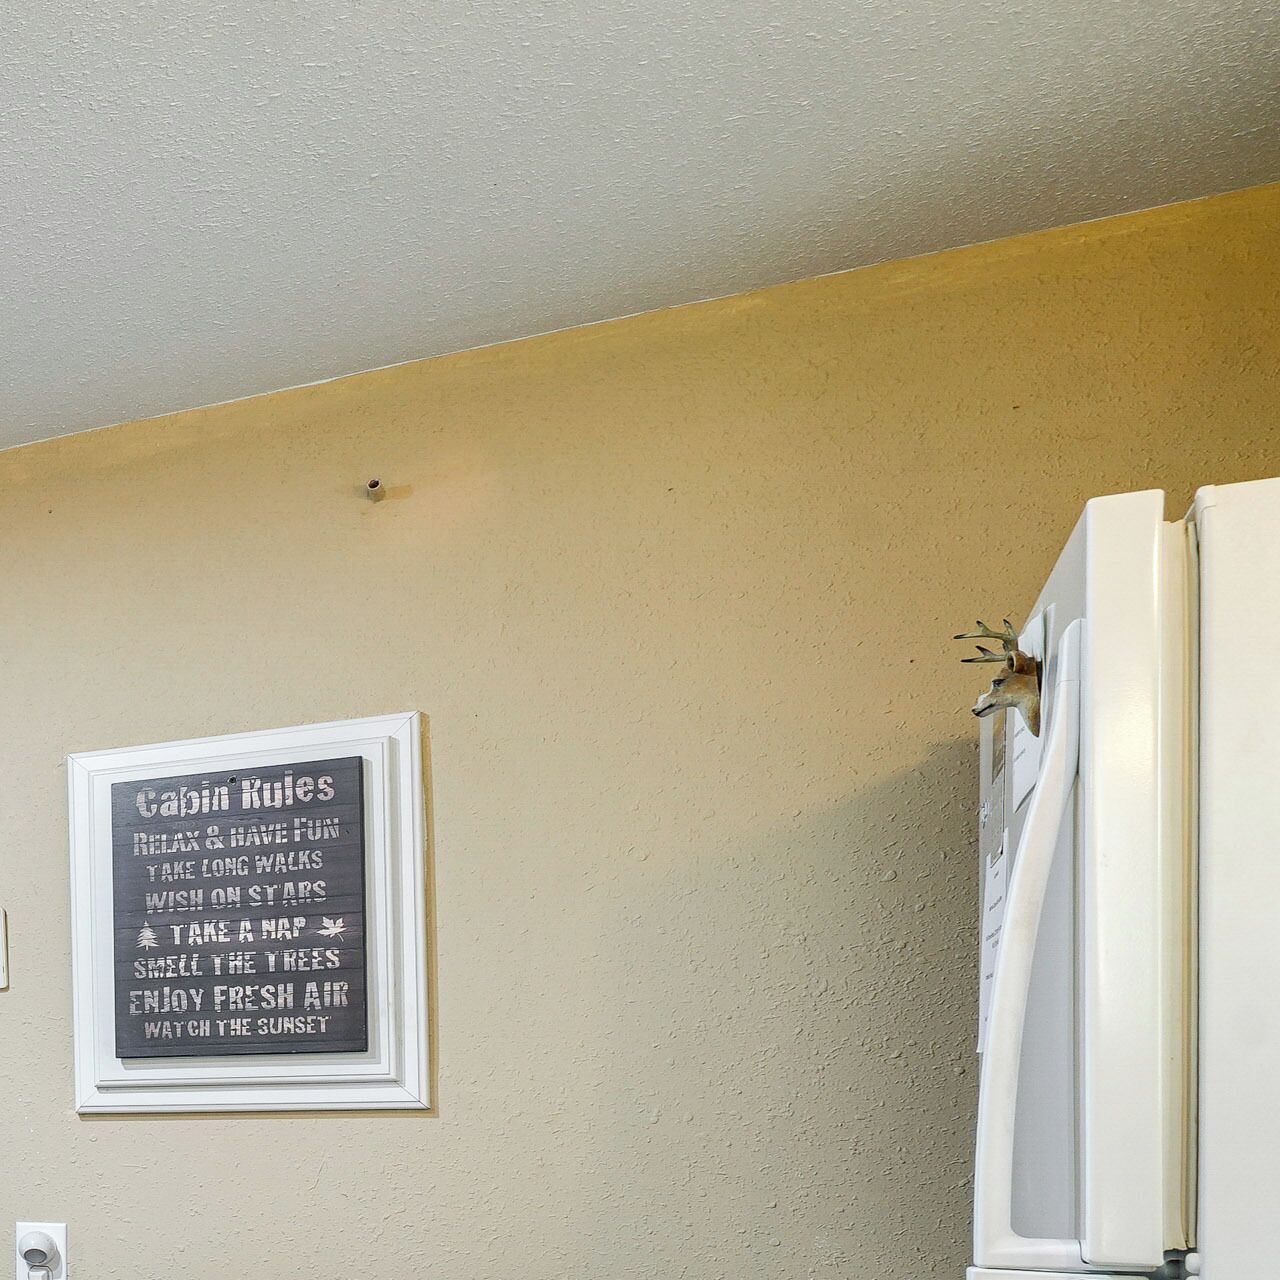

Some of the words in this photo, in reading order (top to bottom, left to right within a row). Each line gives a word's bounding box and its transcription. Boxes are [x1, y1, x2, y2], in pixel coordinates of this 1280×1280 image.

[136, 780, 230, 818] Cabin
[241, 770, 335, 809] Rules
[133, 830, 201, 857] RELAX
[205, 825, 225, 850] &
[230, 822, 288, 848] HAVE
[293, 817, 339, 842] FUN
[146, 861, 196, 883] TAKE
[201, 855, 249, 878] LONG
[255, 850, 324, 874] WALKS
[145, 889, 203, 915] WISH
[211, 886, 241, 910] ON
[248, 880, 327, 908] STARS
[169, 919, 231, 946] TAKE
[238, 917, 254, 944] A
[261, 916, 306, 941] NAP
[133, 953, 203, 979] SMELL
[211, 951, 257, 976] THE
[265, 948, 341, 973] TREES
[129, 986, 205, 1015] ENJOY
[213, 983, 294, 1013] FRESH
[304, 981, 349, 1011] AIR
[144, 1020, 211, 1040] WATCH
[216, 1018, 252, 1037] THE
[257, 1015, 332, 1036] SUNSET
